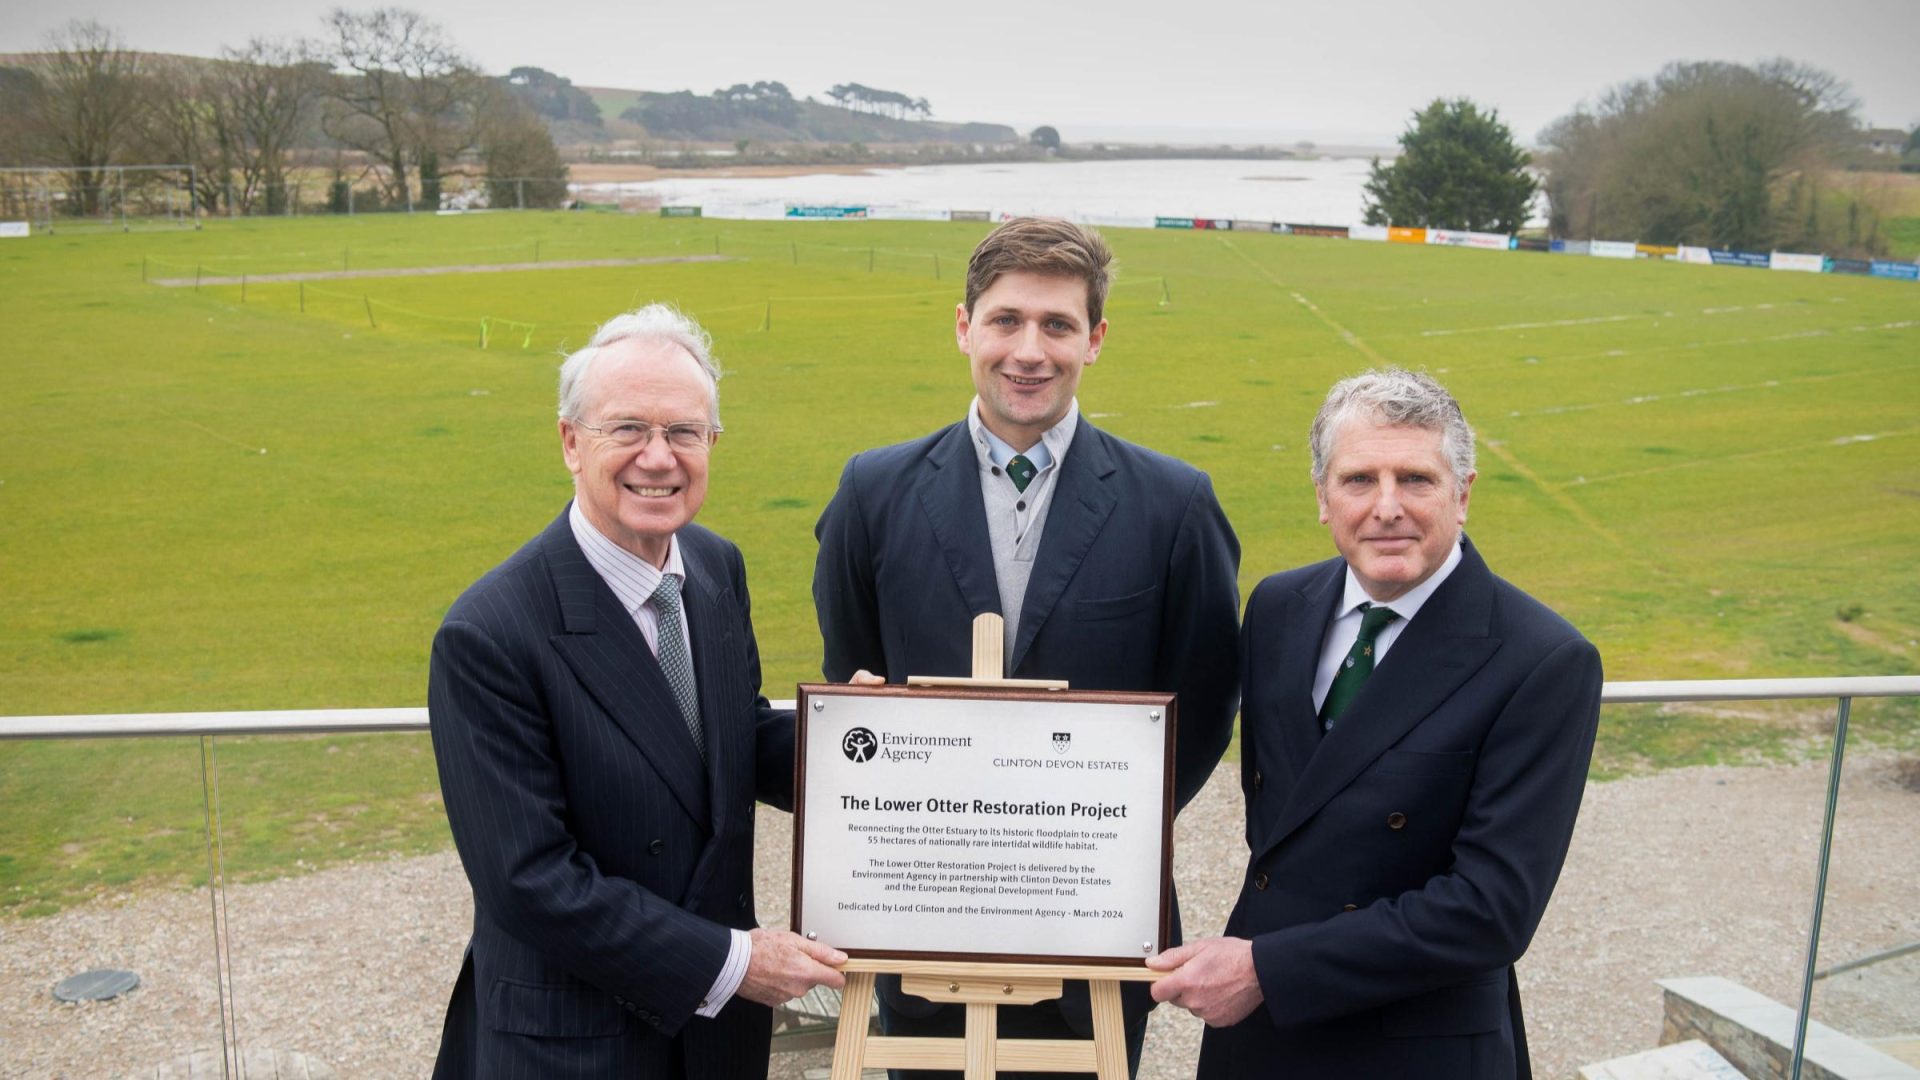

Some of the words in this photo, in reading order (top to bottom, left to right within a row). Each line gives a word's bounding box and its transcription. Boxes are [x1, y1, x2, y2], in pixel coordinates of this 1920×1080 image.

[882, 732, 972, 747] Environment
[880, 747, 932, 764] Agency
[992, 758, 1042, 768] CLINTON
[1046, 760, 1084, 769] DEVON
[1088, 760, 1129, 771] ESTATES
[840, 795, 870, 811] The
[874, 796, 923, 812] Lower
[926, 798, 969, 814] Otter
[973, 799, 1066, 816] Restoration
[1071, 802, 1127, 821] Project
[848, 823, 904, 835] Reconnecting
[906, 825, 920, 833] the
[922, 825, 944, 834] Otter
[946, 826, 978, 837] Estuary
[979, 828, 988, 836] to
[990, 827, 1001, 836] its
[1002, 828, 1034, 837] historic
[1036, 829, 1079, 839] floodplain
[868, 836, 878, 844] 55
[880, 836, 916, 845] hectares
[918, 837, 927, 845] of
[928, 837, 971, 848] nationally
[991, 839, 1030, 848] intertidal
[1032, 840, 1063, 850] wildlife
[1065, 841, 1098, 851] habitat.
[869, 858, 885, 867] The
[886, 859, 912, 868] Lower
[913, 860, 936, 869] Otter
[937, 861, 985, 870] Restoration
[987, 862, 1016, 873] Project
[1018, 863, 1026, 871] is
[1028, 863, 1067, 873] delivered
[1069, 864, 1080, 875] by
[1081, 865, 1095, 873] the
[852, 870, 904, 879] Environment
[906, 871, 937, 882] Agency
[939, 872, 947, 881] in
[949, 874, 998, 884] partnership
[1000, 874, 1018, 883] with
[1020, 875, 1050, 883] Clinton
[1052, 876, 1079, 884] Devon
[1080, 876, 1111, 886] Estates
[884, 882, 900, 891] and
[902, 883, 916, 892] the
[918, 883, 958, 894] European
[960, 885, 996, 895] Regional
[998, 886, 1053, 897] Development
[1055, 887, 1078, 896] Fund.
[838, 902, 880, 911] Dedicated
[882, 903, 893, 913] by
[894, 904, 913, 912] Lord
[915, 904, 945, 913] Clinton
[947, 905, 963, 914] and
[964, 906, 979, 914] the
[980, 906, 1033, 916] Environment
[1034, 908, 1066, 918] Agency
[1073, 909, 1100, 918] March
[1102, 910, 1123, 918] 2024
